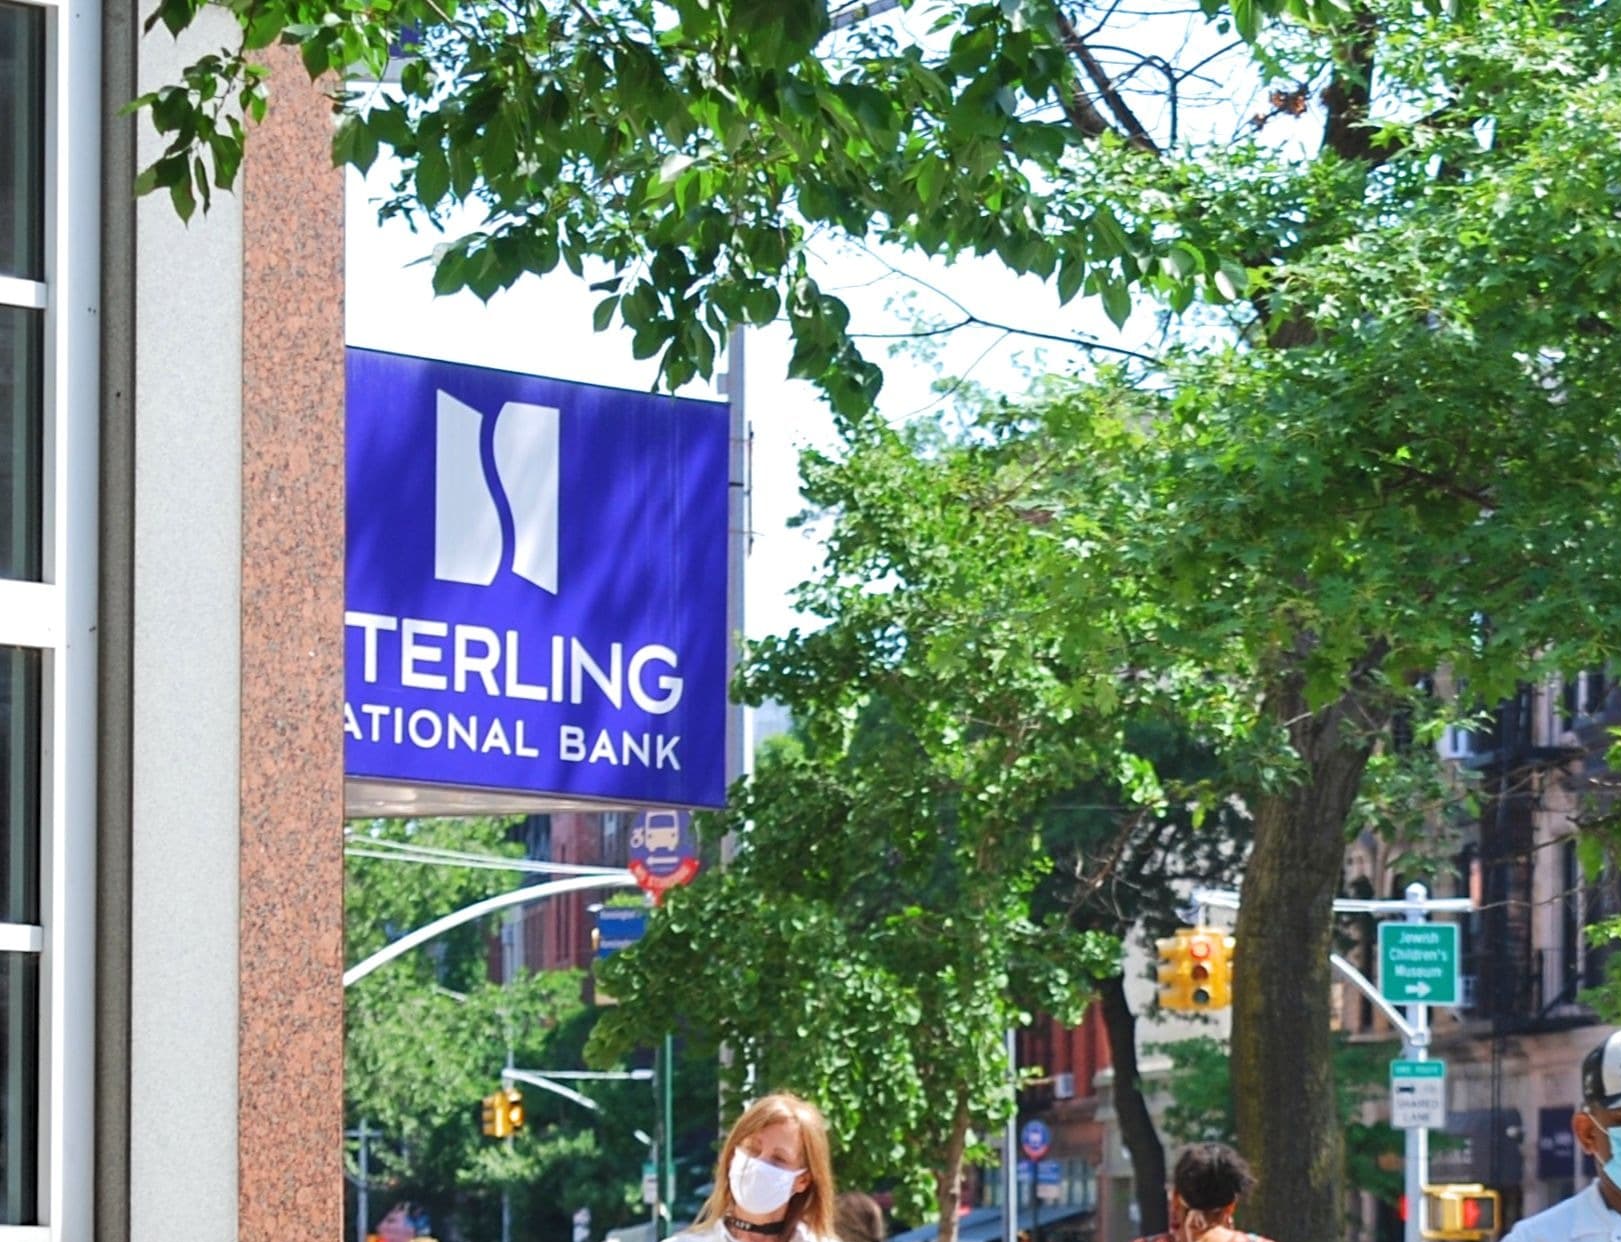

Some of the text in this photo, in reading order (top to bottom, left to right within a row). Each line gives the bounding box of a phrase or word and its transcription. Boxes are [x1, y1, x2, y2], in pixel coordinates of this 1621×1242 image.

[345, 610, 684, 715] TERLING
[344, 703, 681, 771] ATIONAL BANK
[1399, 931, 1439, 944] Jewish
[1389, 947, 1448, 962] Children's
[1394, 964, 1442, 978] Museum
